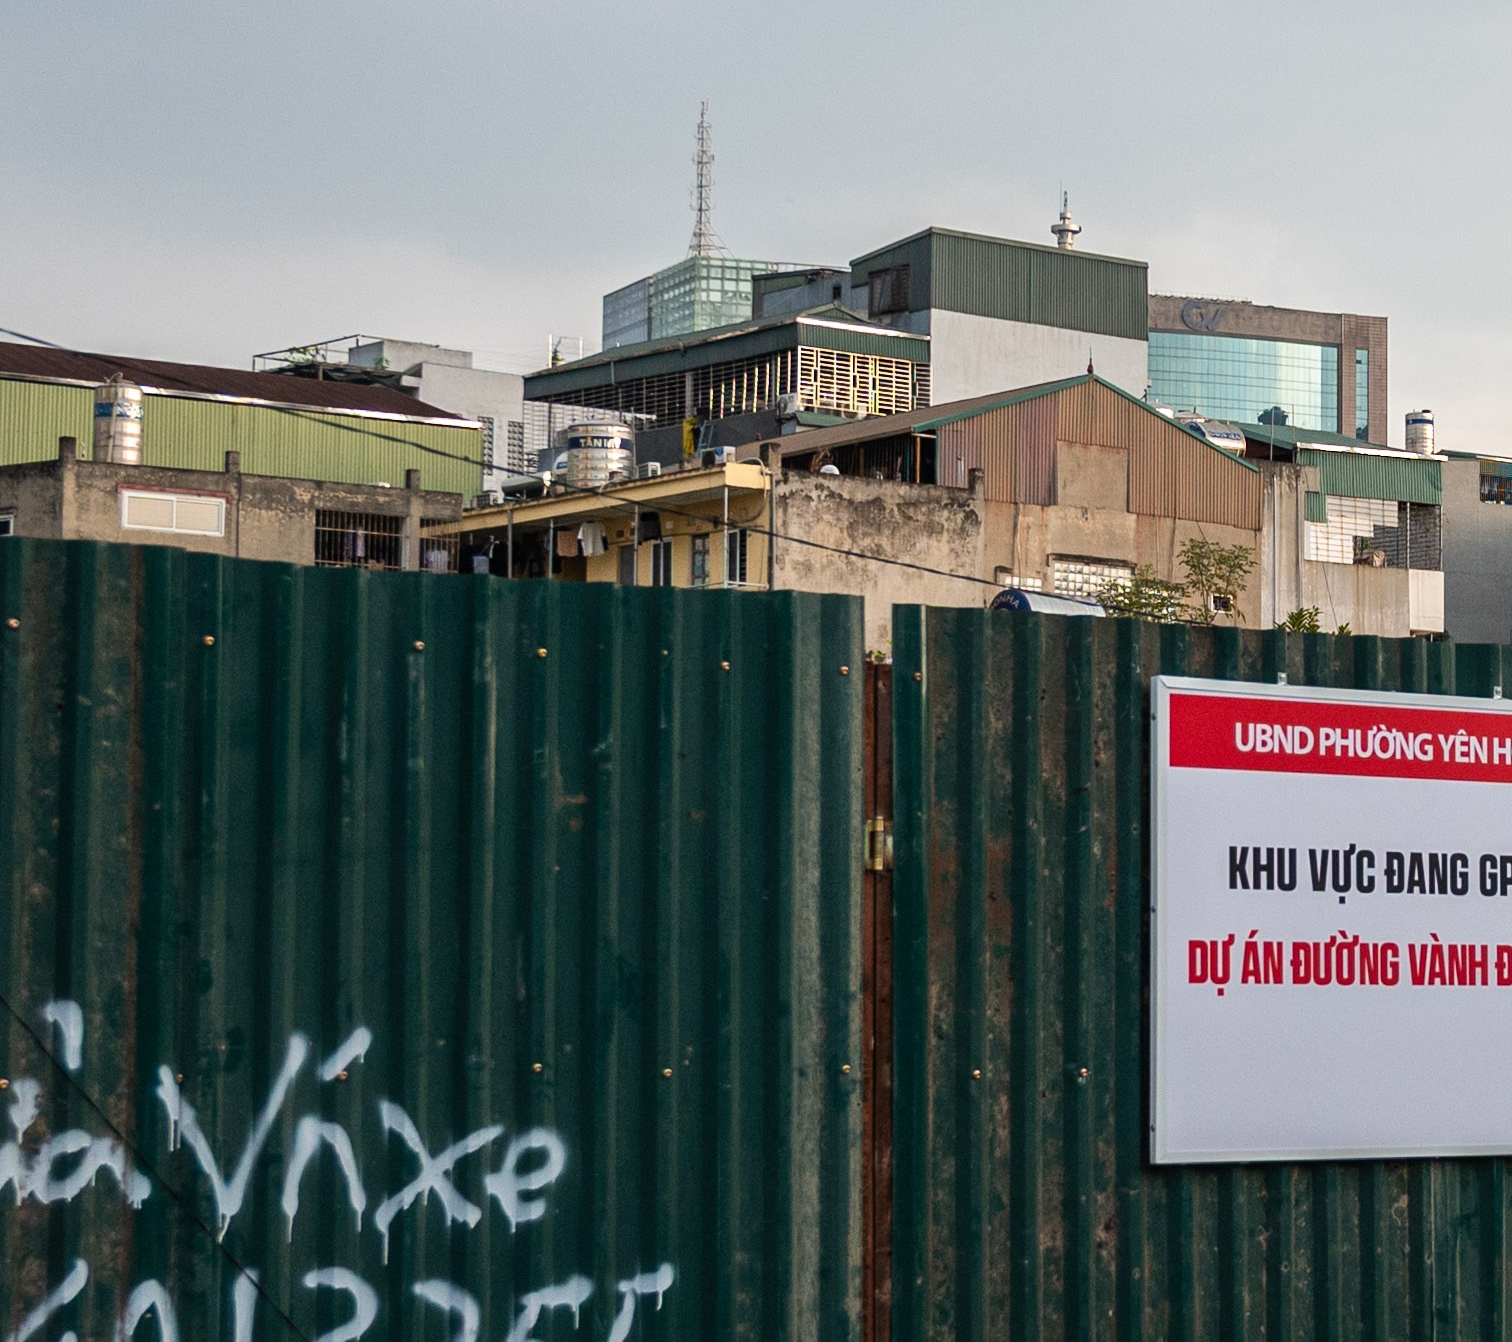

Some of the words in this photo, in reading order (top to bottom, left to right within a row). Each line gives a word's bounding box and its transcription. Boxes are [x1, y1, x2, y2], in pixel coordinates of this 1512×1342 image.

[579, 435, 603, 448] TÂN
[1234, 722, 1315, 754] UBND
[1319, 723, 1434, 761] PHƯỜNG
[1439, 726, 1489, 764] YÊN
[1228, 845, 1297, 891] KHU
[1308, 843, 1376, 904] VỰC
[1384, 851, 1469, 896] ĐANG
[1188, 933, 1235, 996] DỰ
[1241, 929, 1283, 986] ÁN
[1290, 930, 1399, 987] ĐƯỜNG
[1408, 933, 1488, 987] VÀNH
